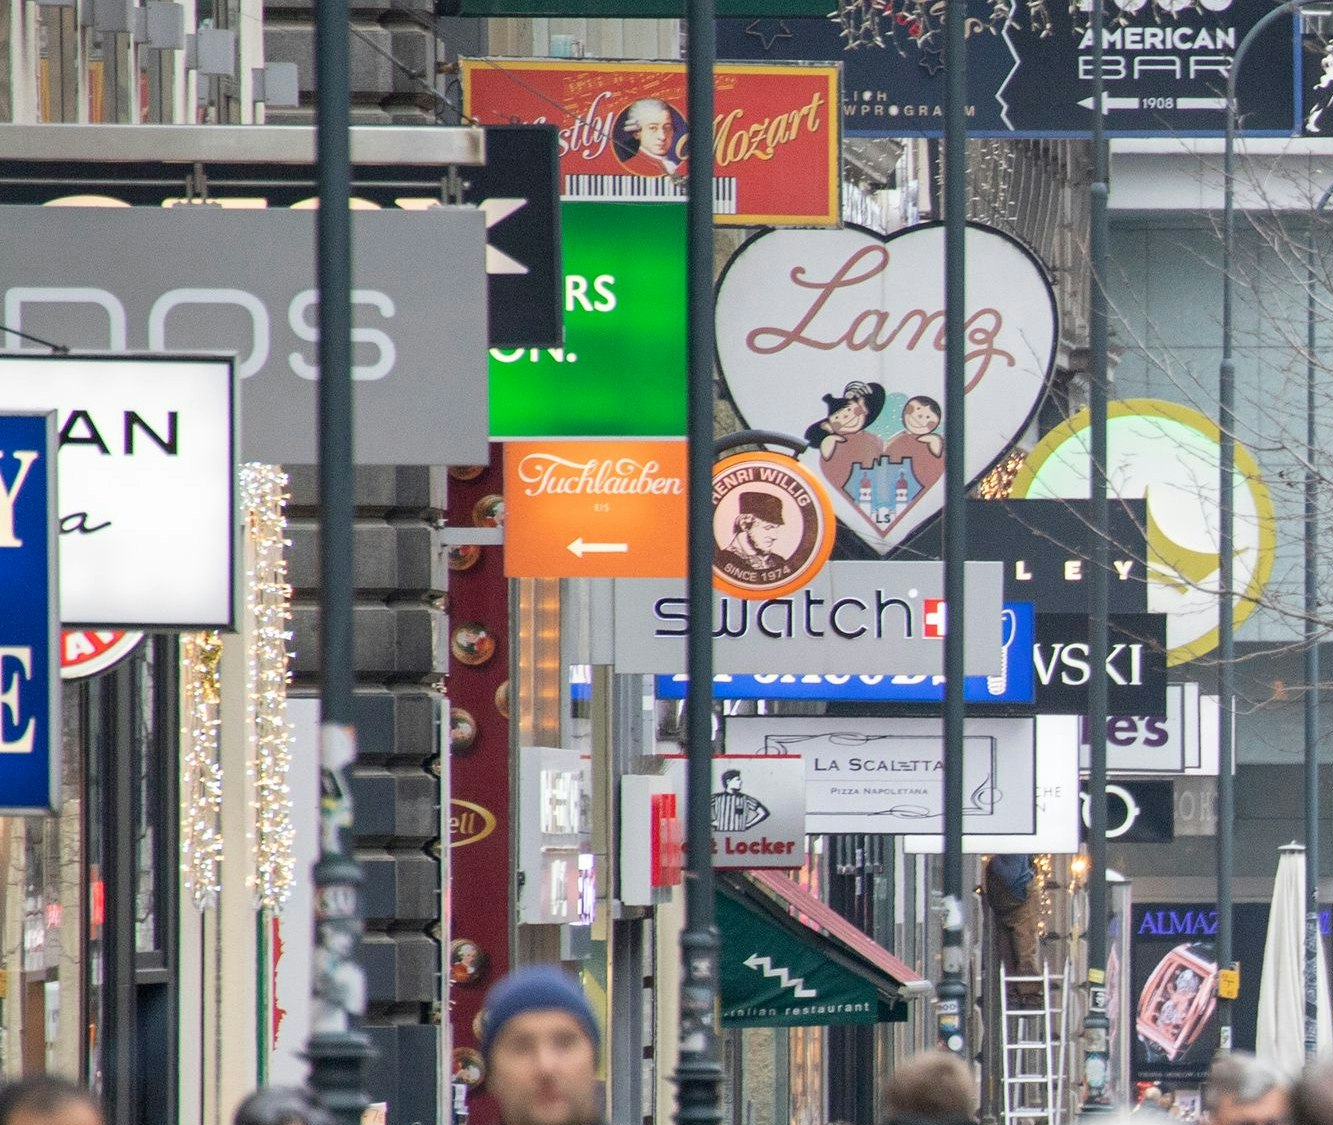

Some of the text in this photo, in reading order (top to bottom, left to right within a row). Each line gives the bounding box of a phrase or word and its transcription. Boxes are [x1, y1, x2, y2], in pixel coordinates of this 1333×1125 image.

[1078, 26, 1236, 50] AMERICAN
[1078, 56, 1235, 80] BAR
[844, 105, 976, 116] WPRGRAM
[1142, 97, 1175, 109] 1908
[745, 244, 1016, 395] Lanz
[59, 410, 178, 455] AN
[518, 453, 683, 497] Tuchlauben
[712, 467, 812, 508] HENRI WILLIG
[876, 513, 891, 524] LS
[723, 563, 792, 583] SINCE 1974
[654, 588, 914, 640] swatch
[830, 787, 929, 796] PIZZA NAPOLETANA
[725, 836, 796, 856] Locker
[784, 1002, 870, 1017] restaurant
